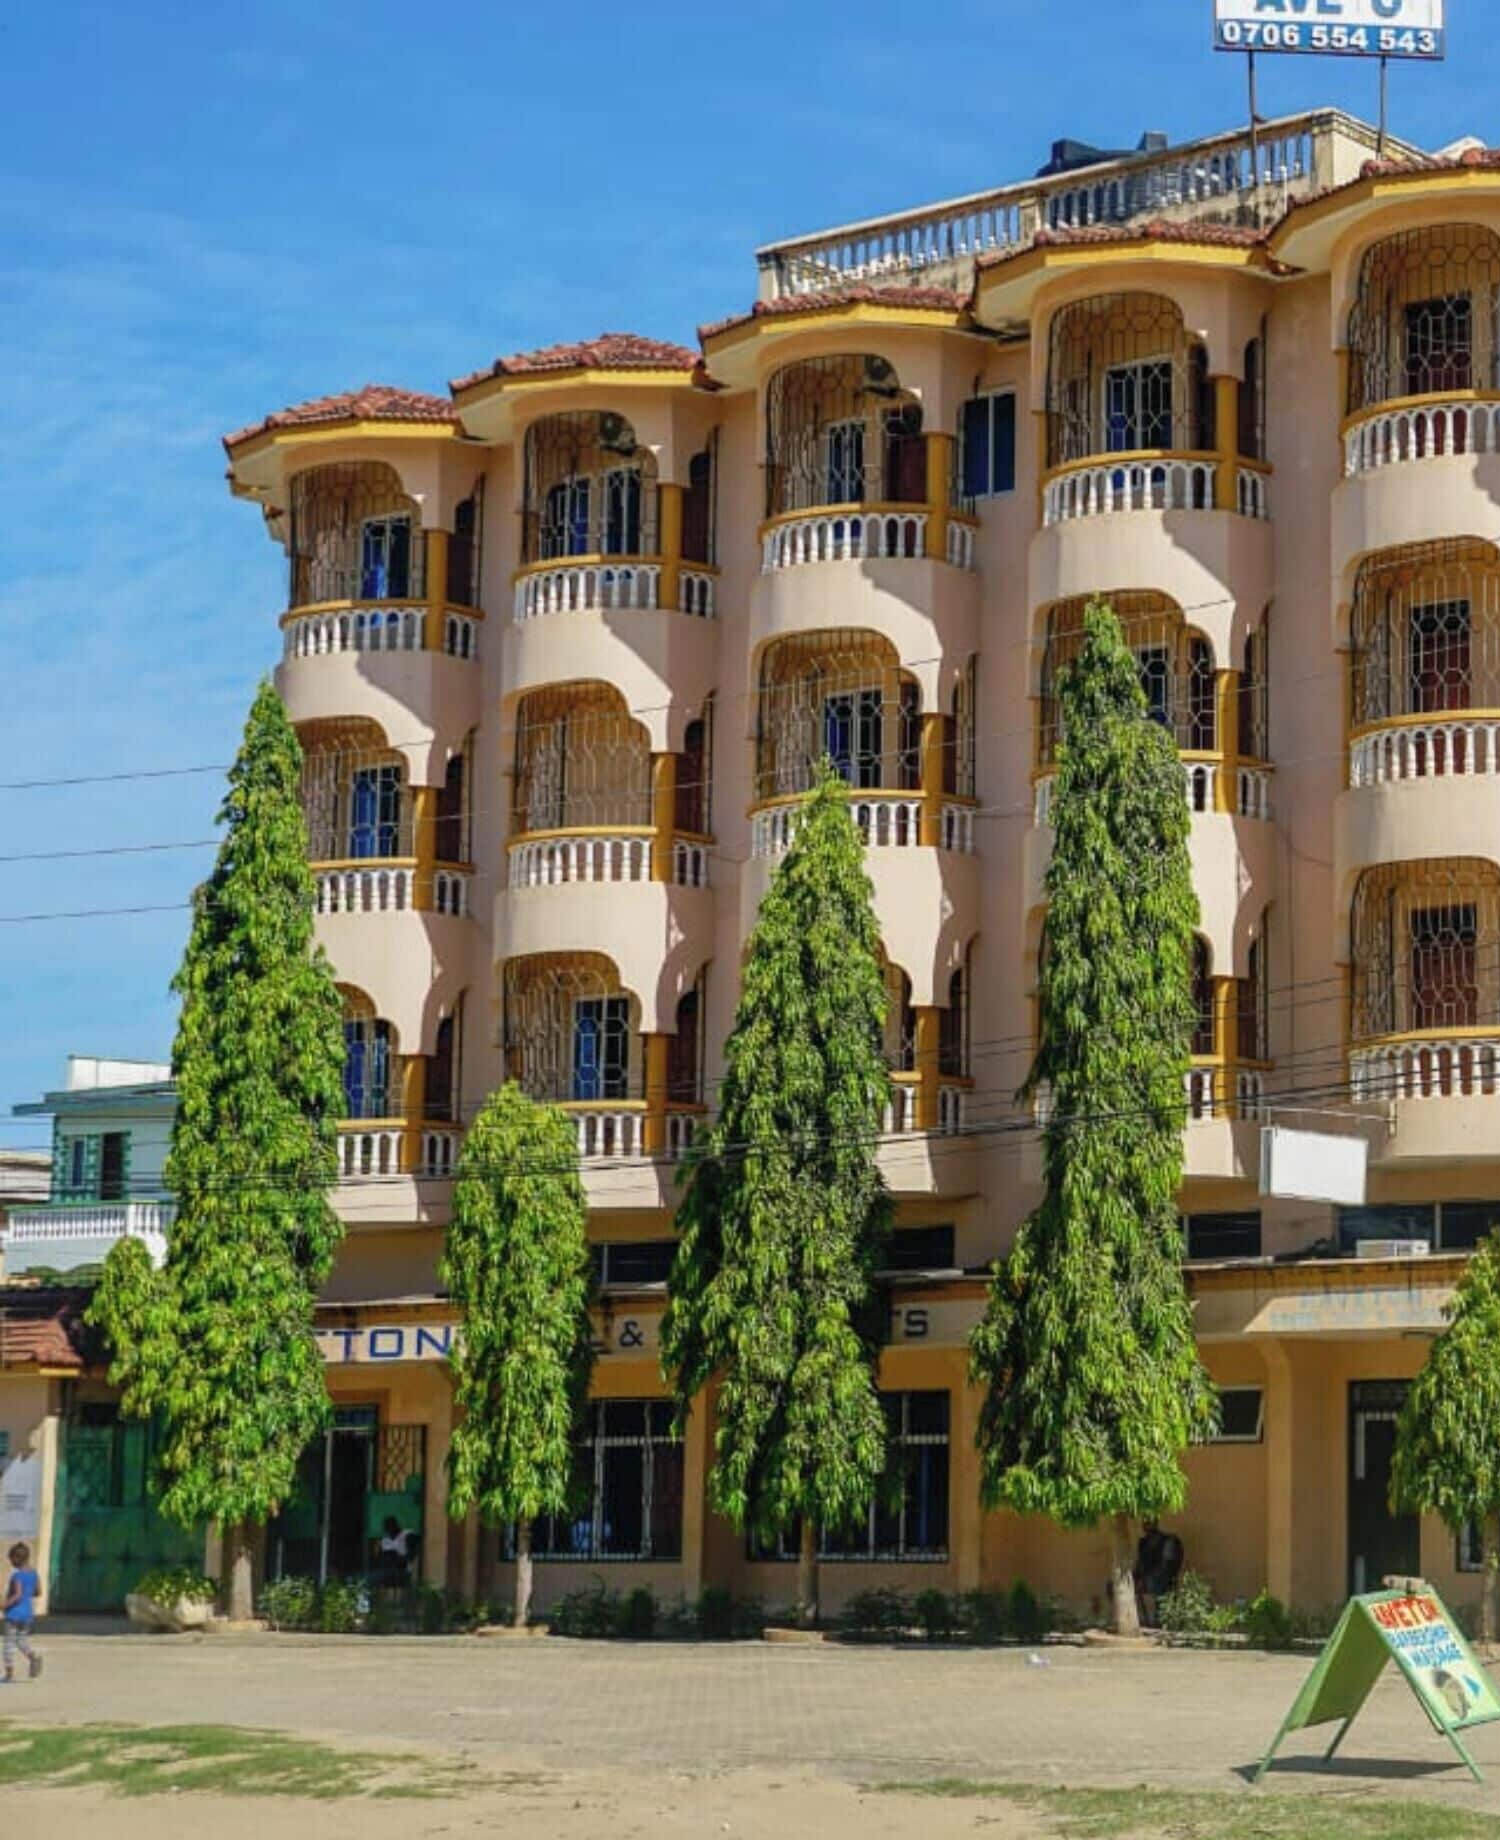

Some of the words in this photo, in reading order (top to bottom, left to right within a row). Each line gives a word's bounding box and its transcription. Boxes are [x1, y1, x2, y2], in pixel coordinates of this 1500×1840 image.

[1223, 21, 1300, 47] 0706
[1311, 25, 1368, 50] 554
[1379, 29, 1436, 53] 543
[316, 1326, 452, 1361] TON
[618, 1320, 644, 1348] &
